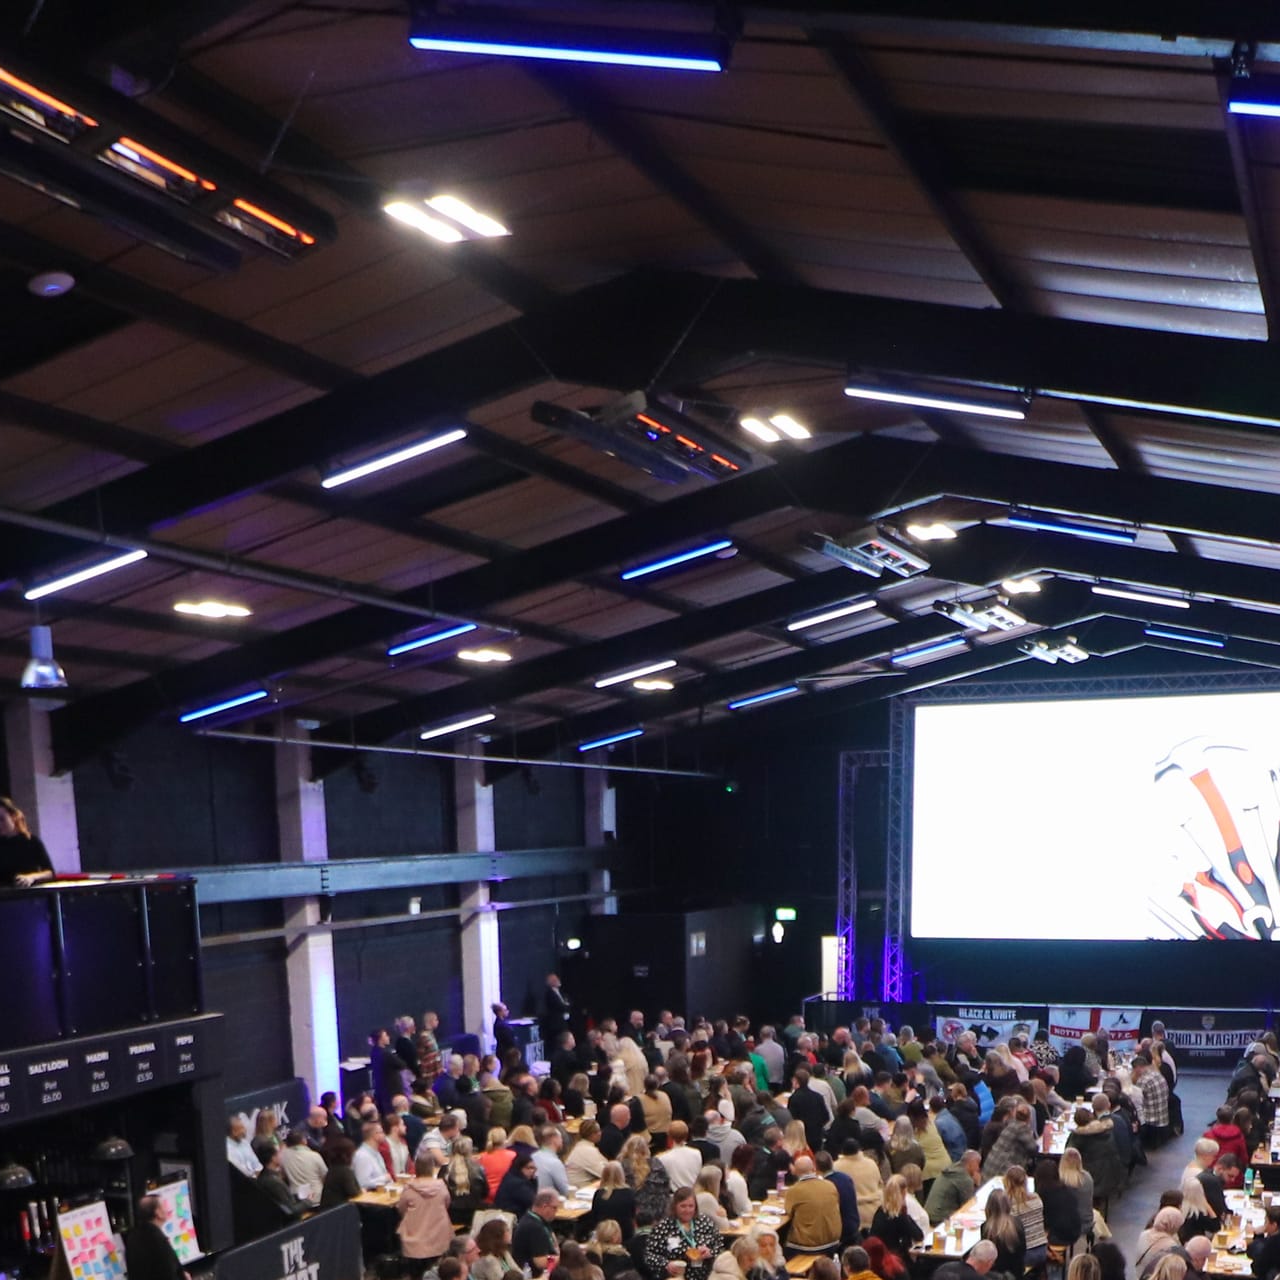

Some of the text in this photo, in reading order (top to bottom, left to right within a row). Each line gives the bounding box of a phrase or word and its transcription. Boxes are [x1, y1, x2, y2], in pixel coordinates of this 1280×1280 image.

[958, 1008, 983, 1019] BLACK
[992, 1009, 1017, 1020] WHITE
[1205, 1032, 1257, 1046] MAGPIES
[281, 1236, 307, 1275] THE
